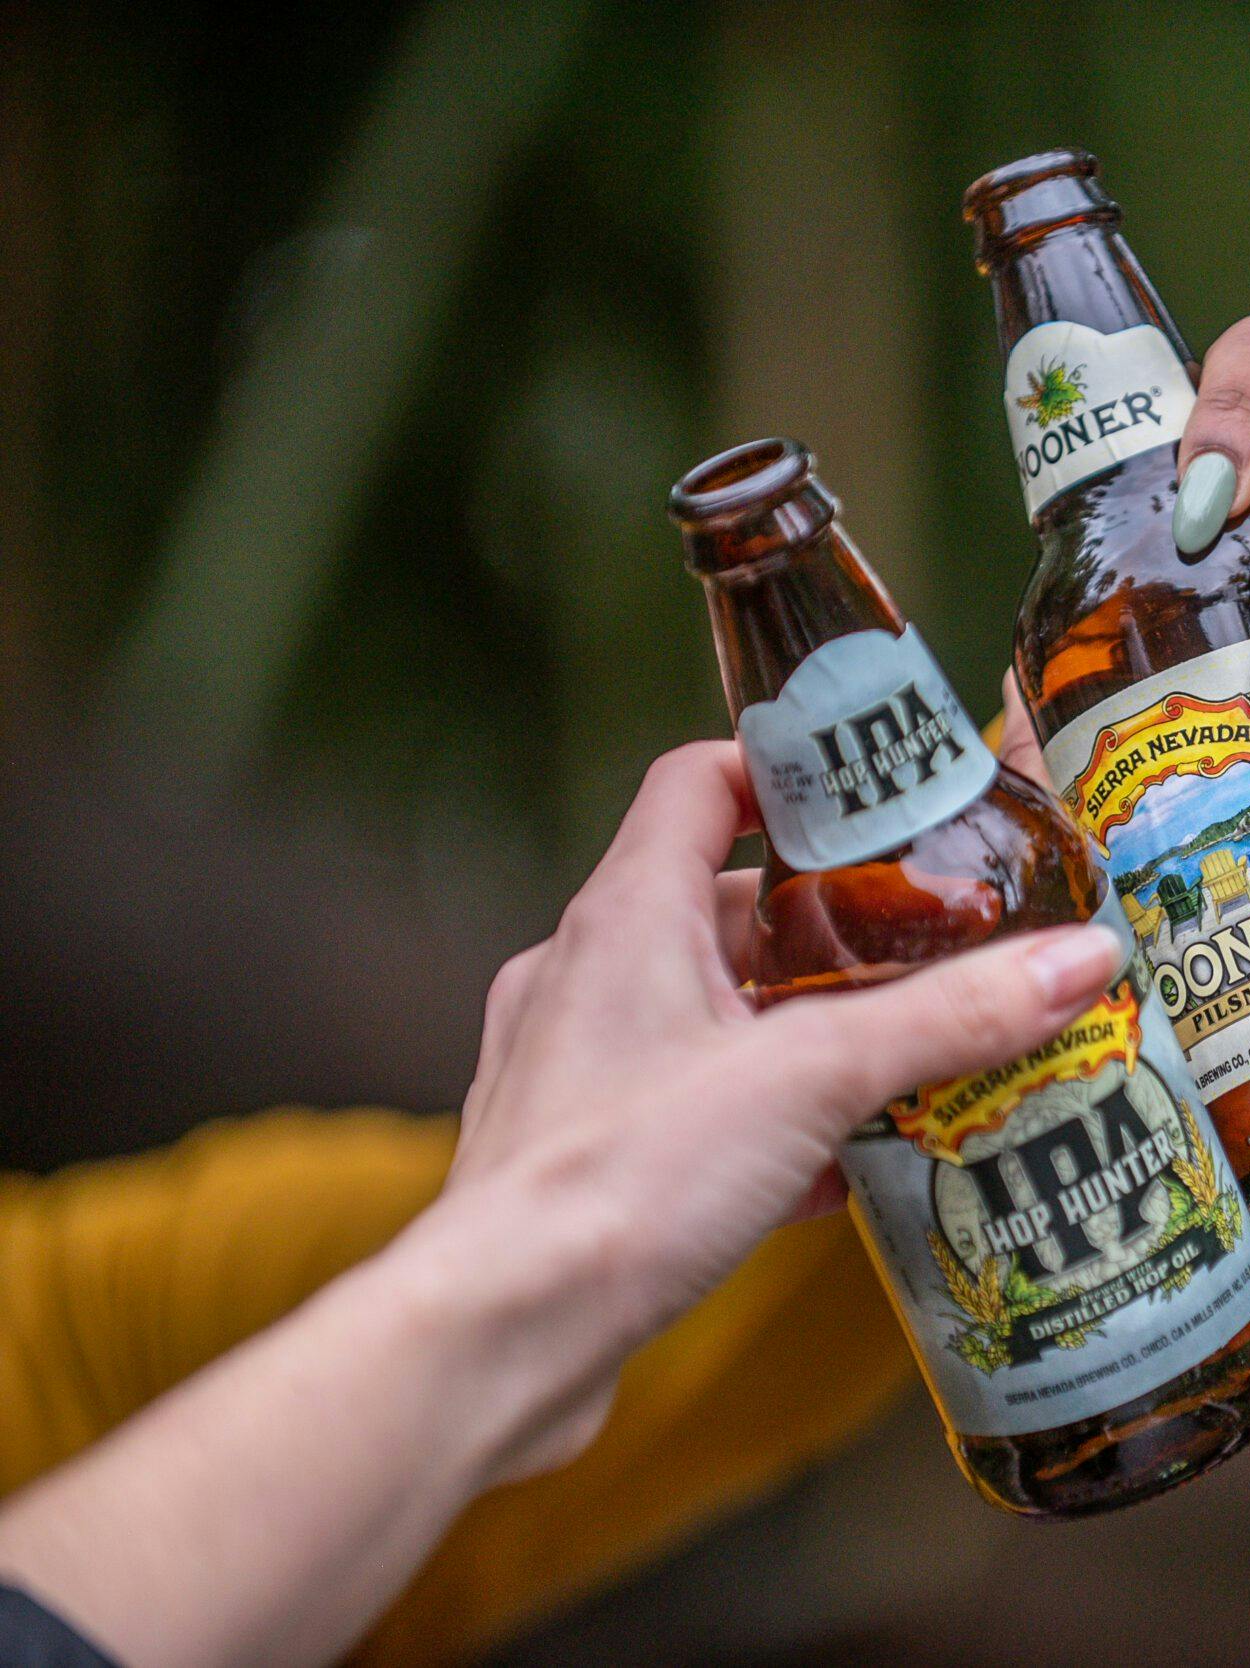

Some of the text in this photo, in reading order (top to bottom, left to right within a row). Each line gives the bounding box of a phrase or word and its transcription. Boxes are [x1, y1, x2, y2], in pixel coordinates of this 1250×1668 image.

[808, 680, 965, 818] IPA
[820, 711, 953, 798] HOP HUNTER
[1085, 749, 1146, 821] SIERRA
[1199, 1061, 1232, 1089] BREWING
[963, 1084, 1174, 1282] IPA
[983, 1201, 1052, 1256] HOP
[1057, 1126, 1178, 1226] HUNTER
[1028, 1242, 1201, 1341] DISTILLED HOP OIL
